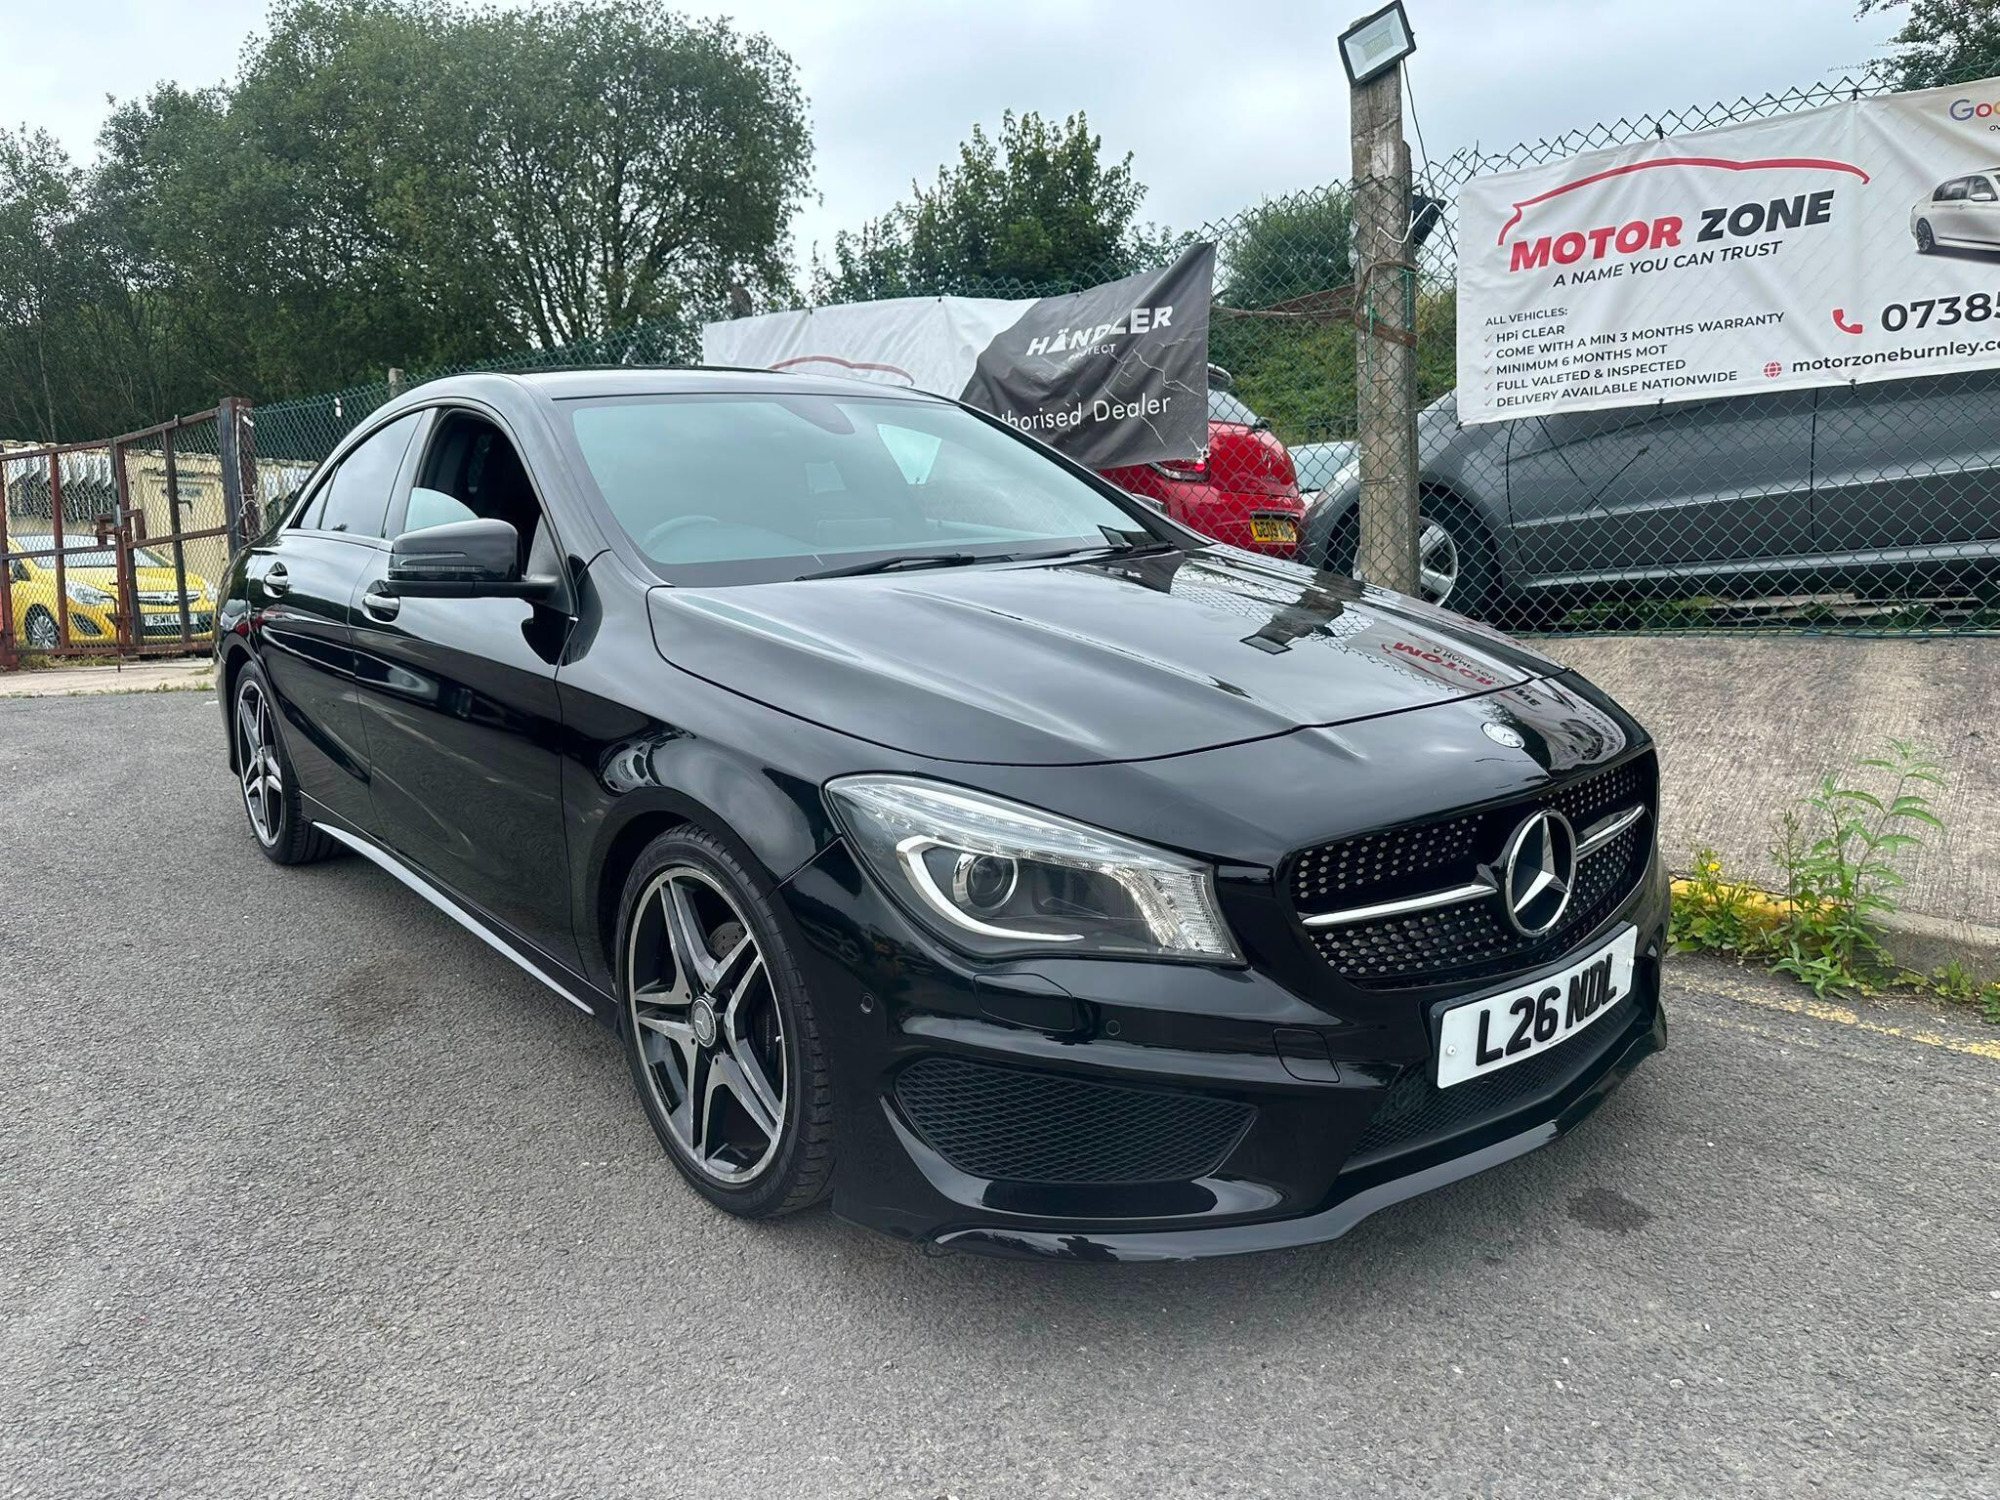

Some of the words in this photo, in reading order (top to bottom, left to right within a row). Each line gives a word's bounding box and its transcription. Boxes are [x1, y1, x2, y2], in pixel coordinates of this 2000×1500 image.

[1509, 216, 1683, 272] MOTOR
[1696, 189, 1835, 243] ZONE
[1553, 274, 1566, 288] A
[1571, 263, 1625, 285] NAME
[1629, 257, 1669, 275] YOU
[1674, 250, 1714, 268] CAN
[1720, 240, 1783, 262] TRUST
[1485, 316, 1507, 327] ALL
[1509, 307, 1568, 323] VEHICLES:
[1881, 291, 2000, 332] 0738
[1496, 331, 1519, 343] HPi
[1522, 325, 1565, 339] CLEAR
[1496, 345, 1535, 359] COME
[1539, 340, 1574, 353] WITH
[1577, 338, 1586, 348] A
[1590, 333, 1616, 346] MIN
[1620, 332, 1628, 343] 3
[1632, 323, 1694, 341] MONTHS
[1698, 312, 1785, 333] WARRANTY
[1496, 358, 1558, 375] MINIMUM
[1562, 356, 1570, 366] 6
[1573, 348, 1632, 364] MONTHS
[1636, 344, 1668, 358] MOT
[1792, 340, 2000, 373] motorzoneburnley.c
[1496, 379, 1529, 392] FULL
[1531, 370, 1590, 387] VALETED
[1594, 369, 1604, 379] &
[1607, 359, 1686, 378] INSPECTED
[1497, 390, 1559, 407] DELIVERY
[1561, 381, 1638, 399] AVAILABLE
[1641, 371, 1738, 390] NATIONWIDE
[1093, 392, 1172, 422] Dealer
[1475, 986, 1562, 1066] L26
[1565, 952, 1617, 1030] NDL
